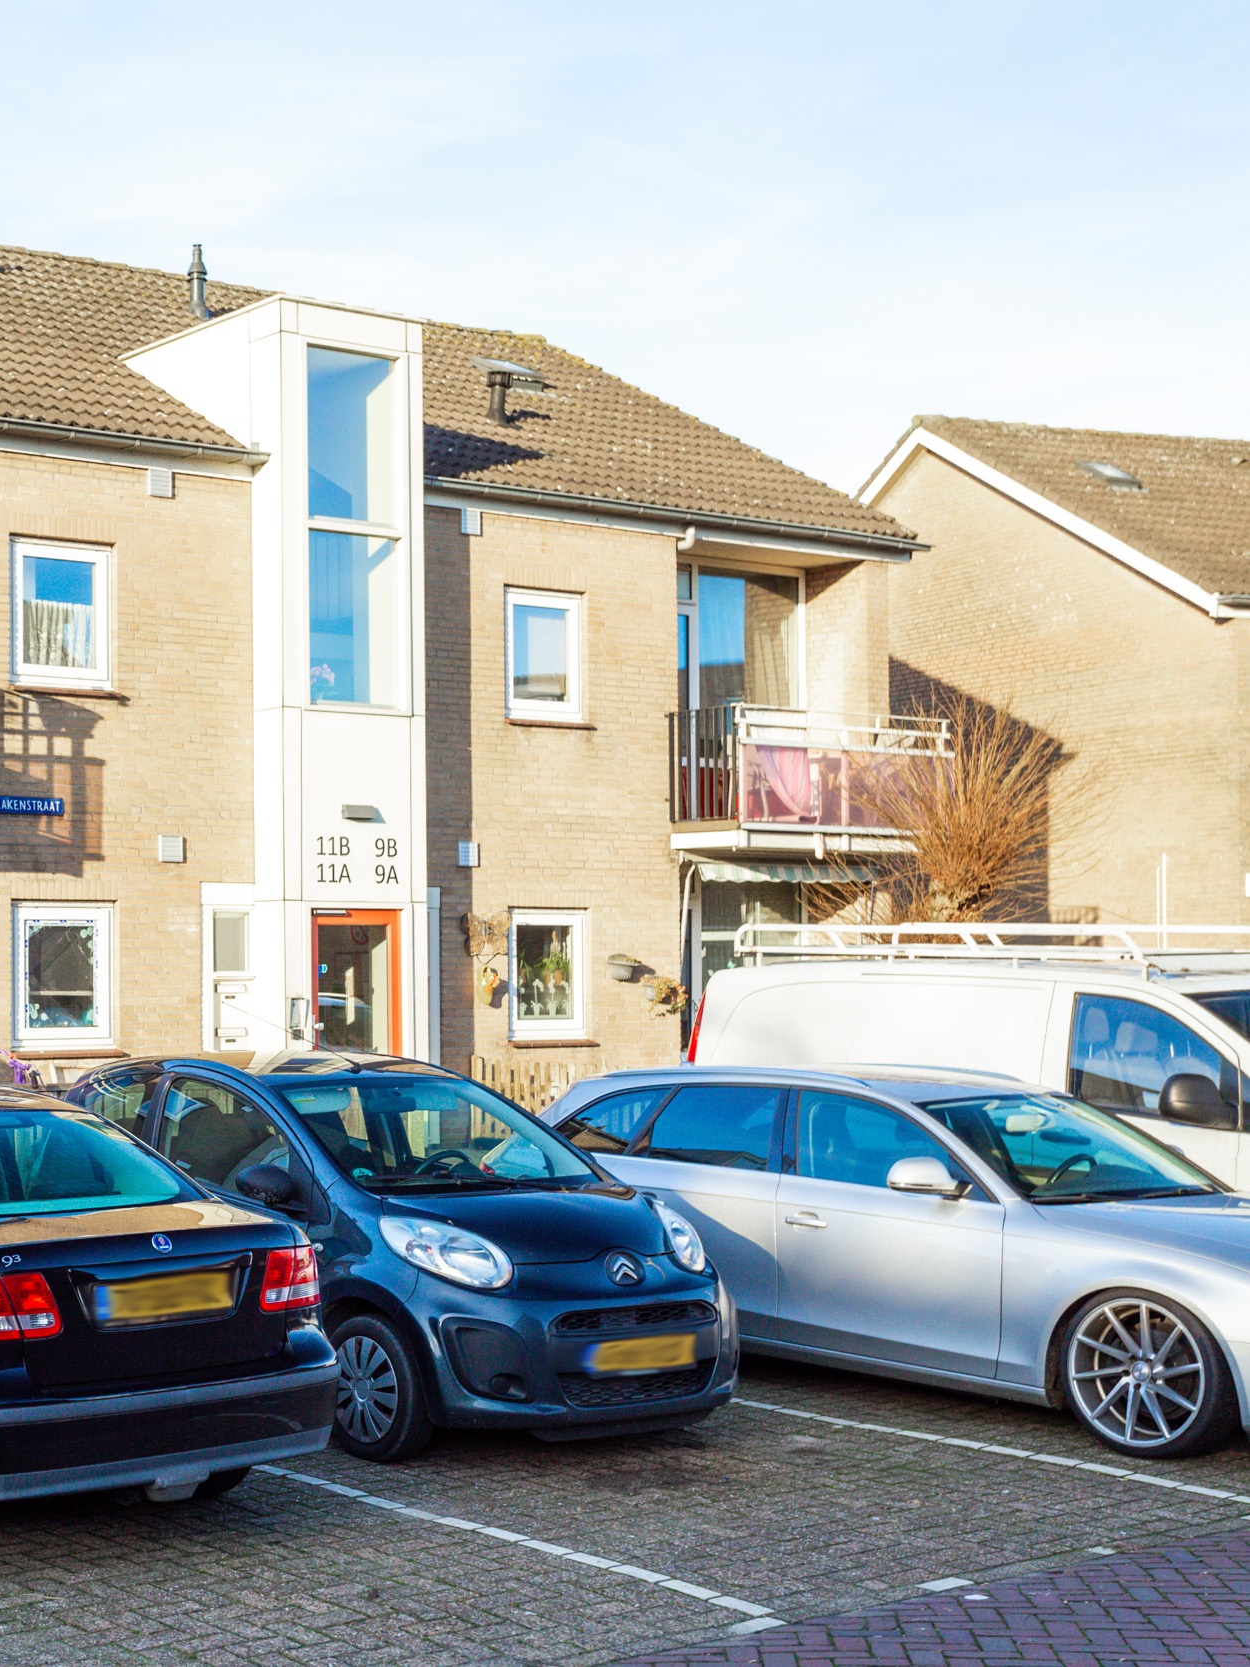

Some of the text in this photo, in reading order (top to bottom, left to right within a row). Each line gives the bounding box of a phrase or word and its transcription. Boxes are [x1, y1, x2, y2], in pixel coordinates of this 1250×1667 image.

[316, 836, 398, 857] 11B 9B
[316, 863, 399, 885] 11A 9A
